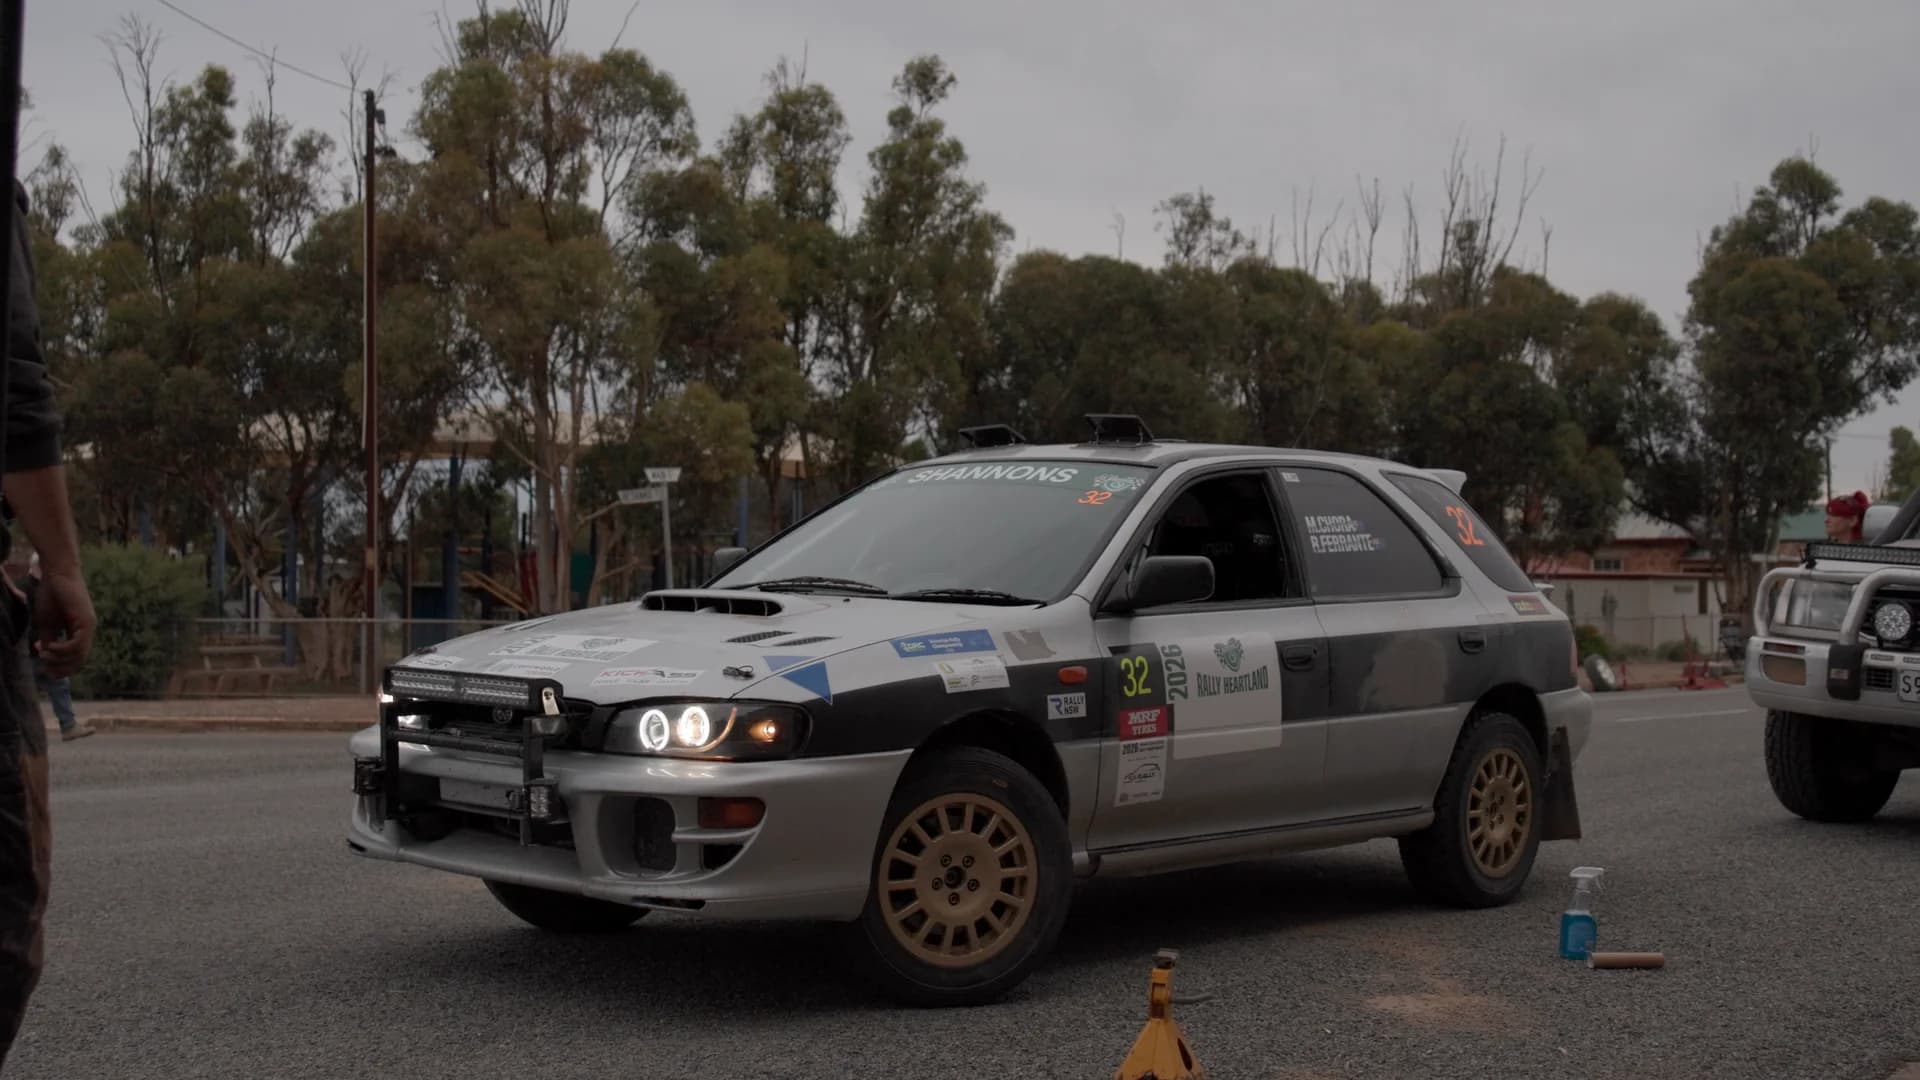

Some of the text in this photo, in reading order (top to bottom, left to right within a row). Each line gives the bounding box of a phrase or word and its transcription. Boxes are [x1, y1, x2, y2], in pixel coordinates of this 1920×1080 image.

[908, 465, 1079, 484] SHANNONS
[1076, 490, 1113, 505] 32
[1445, 505, 1485, 546] 32
[1120, 655, 1152, 697] 32
[1162, 644, 1188, 700] 2026
[1196, 665, 1269, 697] RALLY HEARTLAND
[1063, 696, 1085, 705] RALLY
[1064, 704, 1080, 715] NSW
[1128, 709, 1161, 725] MRF
[1132, 723, 1157, 736] TYRES
